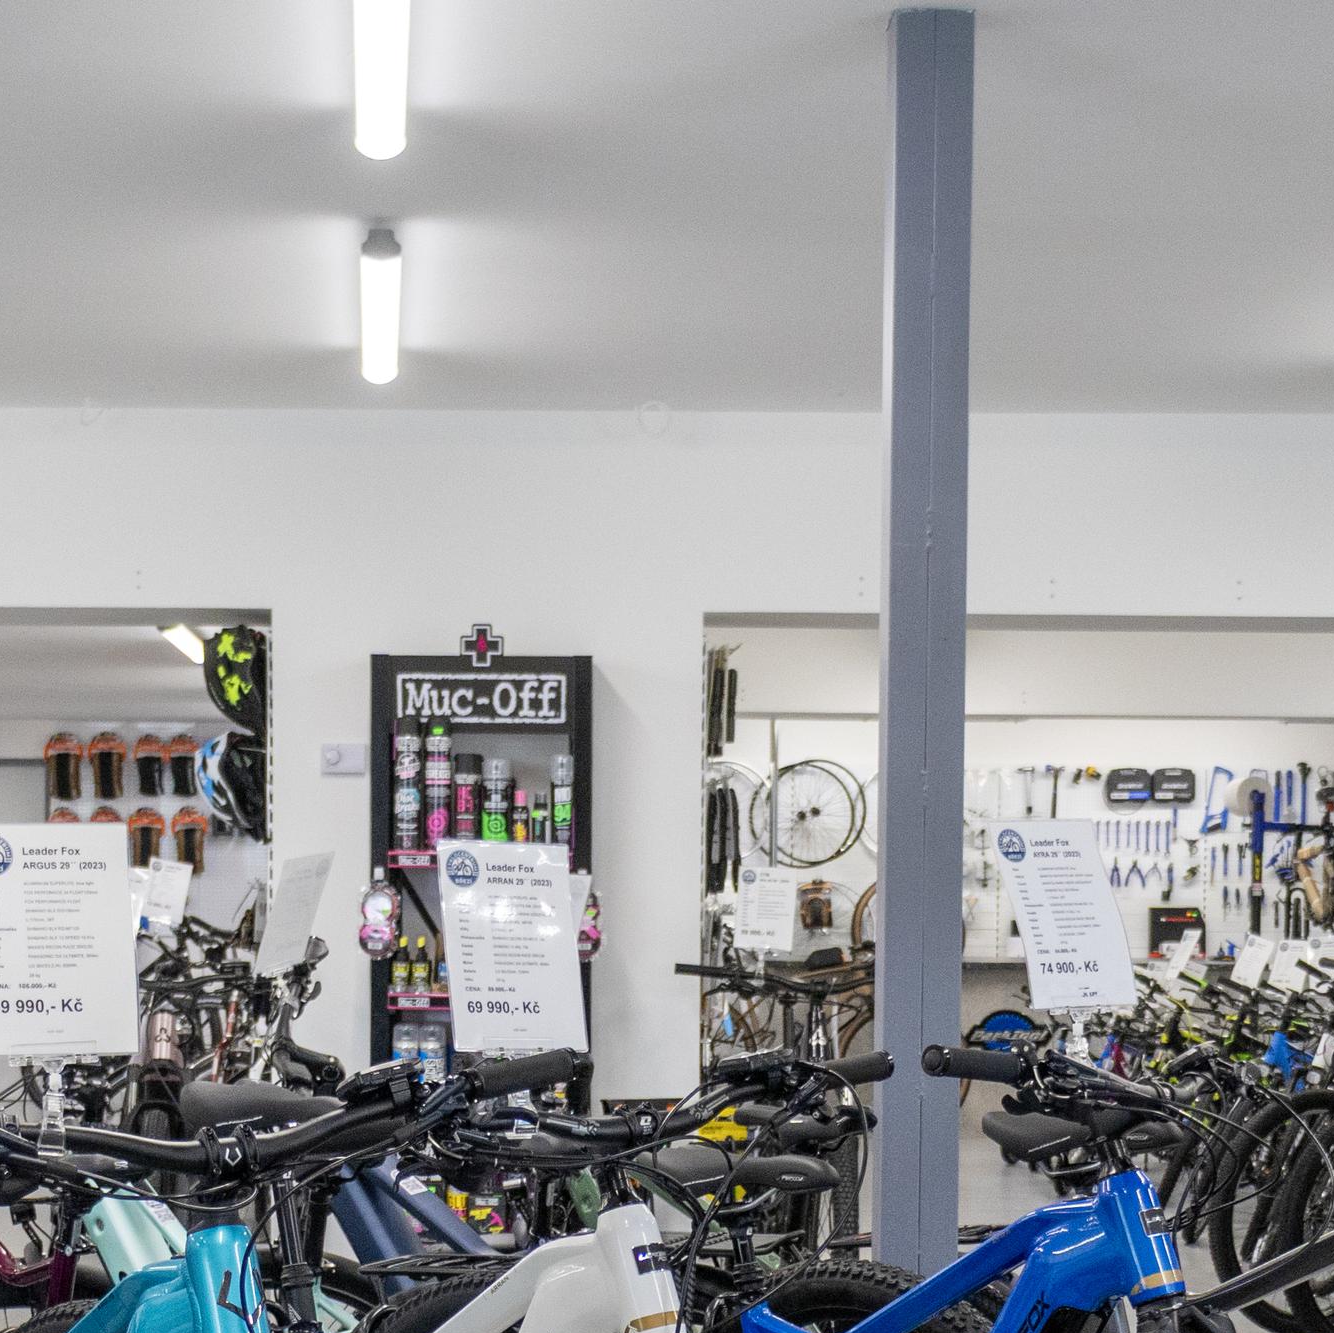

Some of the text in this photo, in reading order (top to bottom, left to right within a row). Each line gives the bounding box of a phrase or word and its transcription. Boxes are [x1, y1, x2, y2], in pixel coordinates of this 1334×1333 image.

[405, 681, 559, 717] Muc-Off
[1029, 839, 1054, 847] Leader
[22, 847, 81, 856] Leader Fox
[22, 862, 57, 870] ARGUS
[79, 861, 107, 871] (2023)
[486, 863, 535, 873] Leader Fox
[487, 877, 514, 885] ARRAN
[531, 879, 552, 888] (2023)
[1040, 961, 1099, 975] 74 900,- Kč
[15, 999, 56, 1015] 990,-
[61, 998, 83, 1012] Kč
[467, 1001, 540, 1016] 69 990,- Kč
